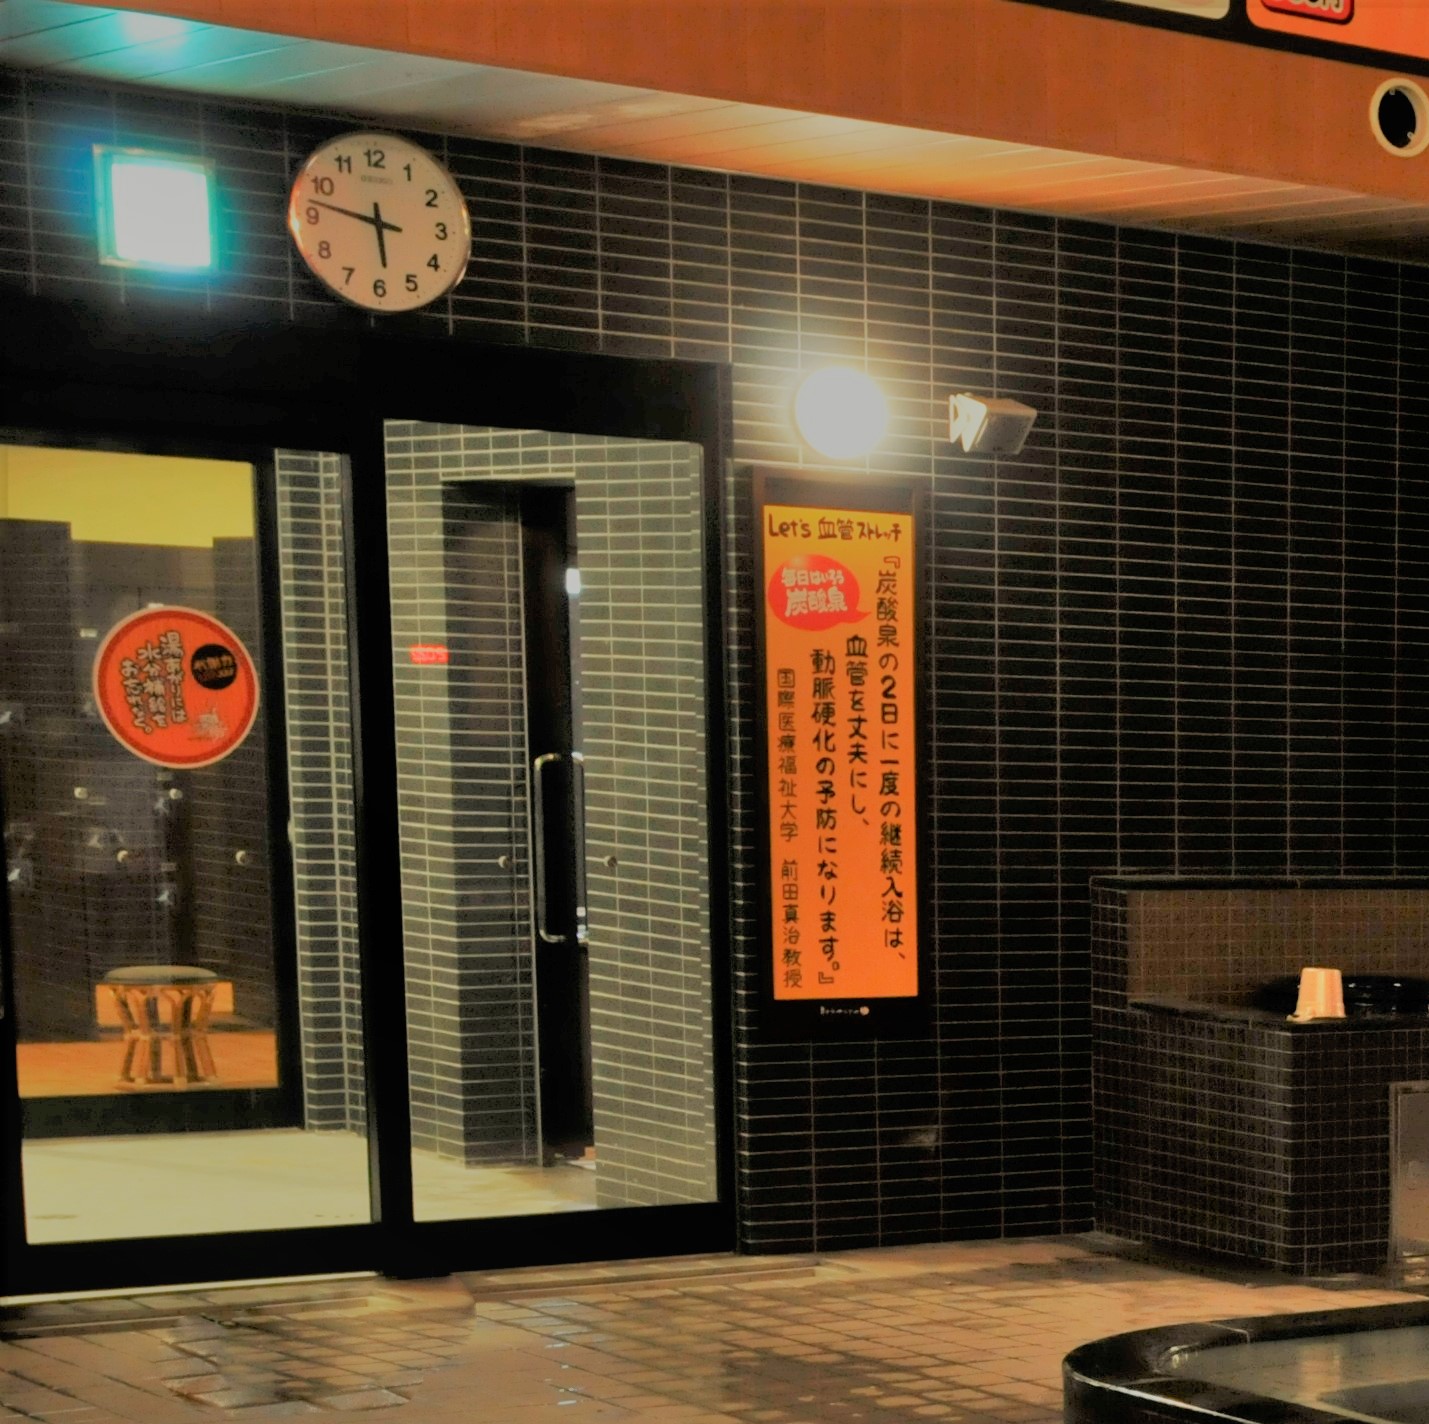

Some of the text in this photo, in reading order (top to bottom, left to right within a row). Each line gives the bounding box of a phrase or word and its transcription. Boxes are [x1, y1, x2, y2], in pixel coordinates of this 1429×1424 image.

[334, 155, 352, 174] 11
[364, 149, 385, 168] 12
[403, 163, 411, 181] 1
[311, 177, 334, 196] 10
[425, 189, 438, 208] 2
[306, 207, 319, 225] 9
[435, 223, 448, 240] 3
[318, 241, 332, 259] 8
[427, 254, 440, 272] 4
[342, 266, 355, 285] 7
[405, 274, 418, 292] 5
[373, 279, 387, 298] 6
[768, 513, 901, 542] Let's 血管ストレッチ
[785, 586, 847, 617] 炭酸泉
[845, 635, 869, 826] 血管を丈夫にし、
[810, 649, 840, 985] 動脈硬化の予防になります。』
[777, 668, 802, 988] 国際医療福祉大学 前田真治教授
